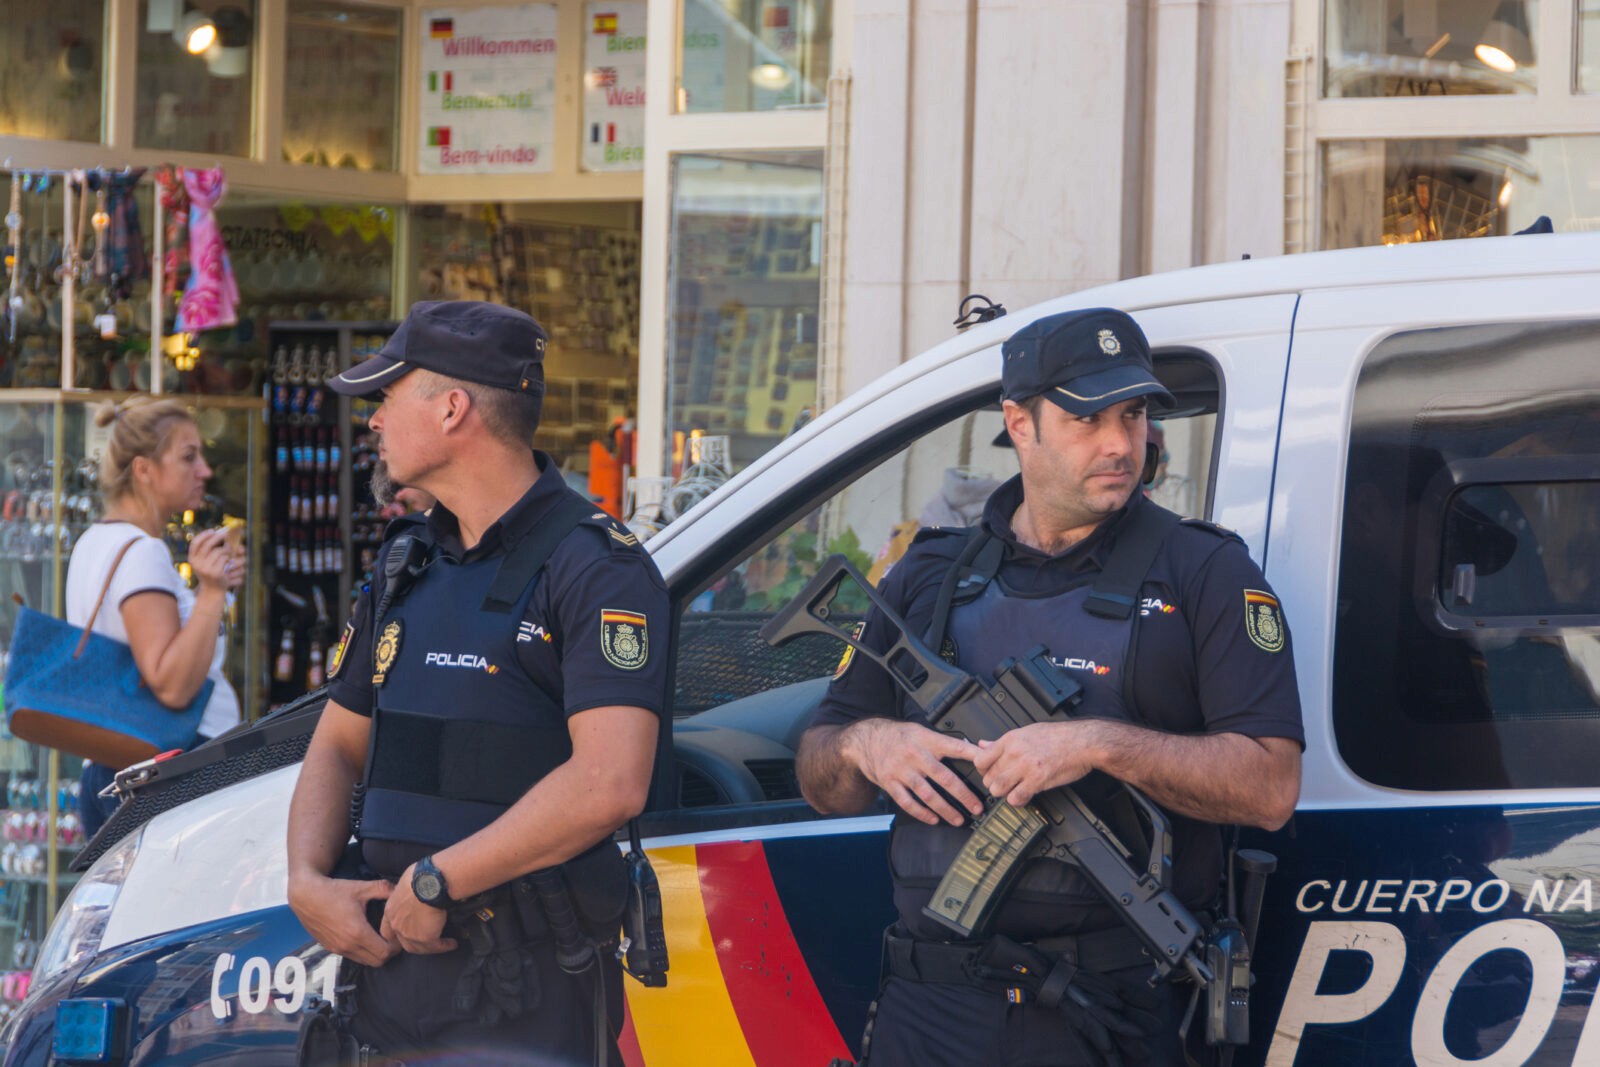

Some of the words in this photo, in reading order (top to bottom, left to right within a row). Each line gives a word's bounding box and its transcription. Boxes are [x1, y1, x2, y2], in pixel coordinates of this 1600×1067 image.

[442, 36, 556, 57] Willkommen
[441, 89, 533, 110] Benvenuti
[440, 144, 537, 166] Bem-vindo
[425, 652, 488, 669] POLICIA
[1295, 879, 1510, 913] CUERPO
[1523, 879, 1593, 913] NA
[238, 955, 343, 1014] 091
[1263, 918, 1600, 1067] PO
